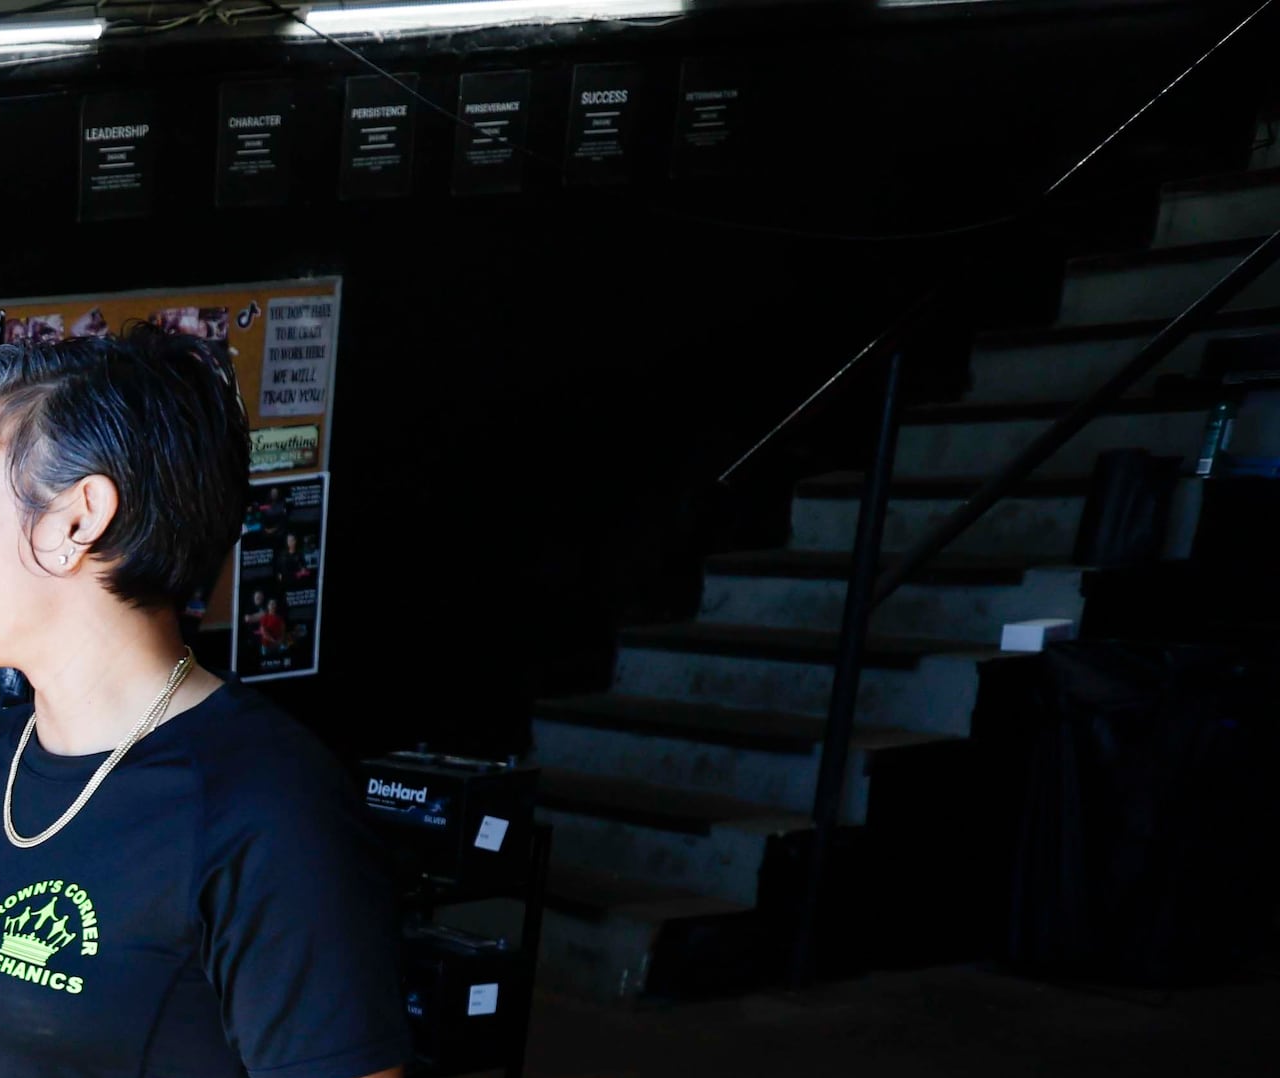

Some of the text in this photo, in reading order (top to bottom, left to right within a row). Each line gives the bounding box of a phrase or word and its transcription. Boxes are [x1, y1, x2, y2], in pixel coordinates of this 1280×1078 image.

[581, 88, 629, 106] SUCCESS
[351, 104, 408, 121] PERSISTENCE
[464, 100, 521, 115] PERSEVERANCE
[229, 114, 282, 129] CHARACTER
[85, 124, 150, 141] LEADERSHIP
[368, 778, 428, 804] DieHard
[423, 814, 447, 827] SILVER
[64, 883, 99, 956] CORNER
